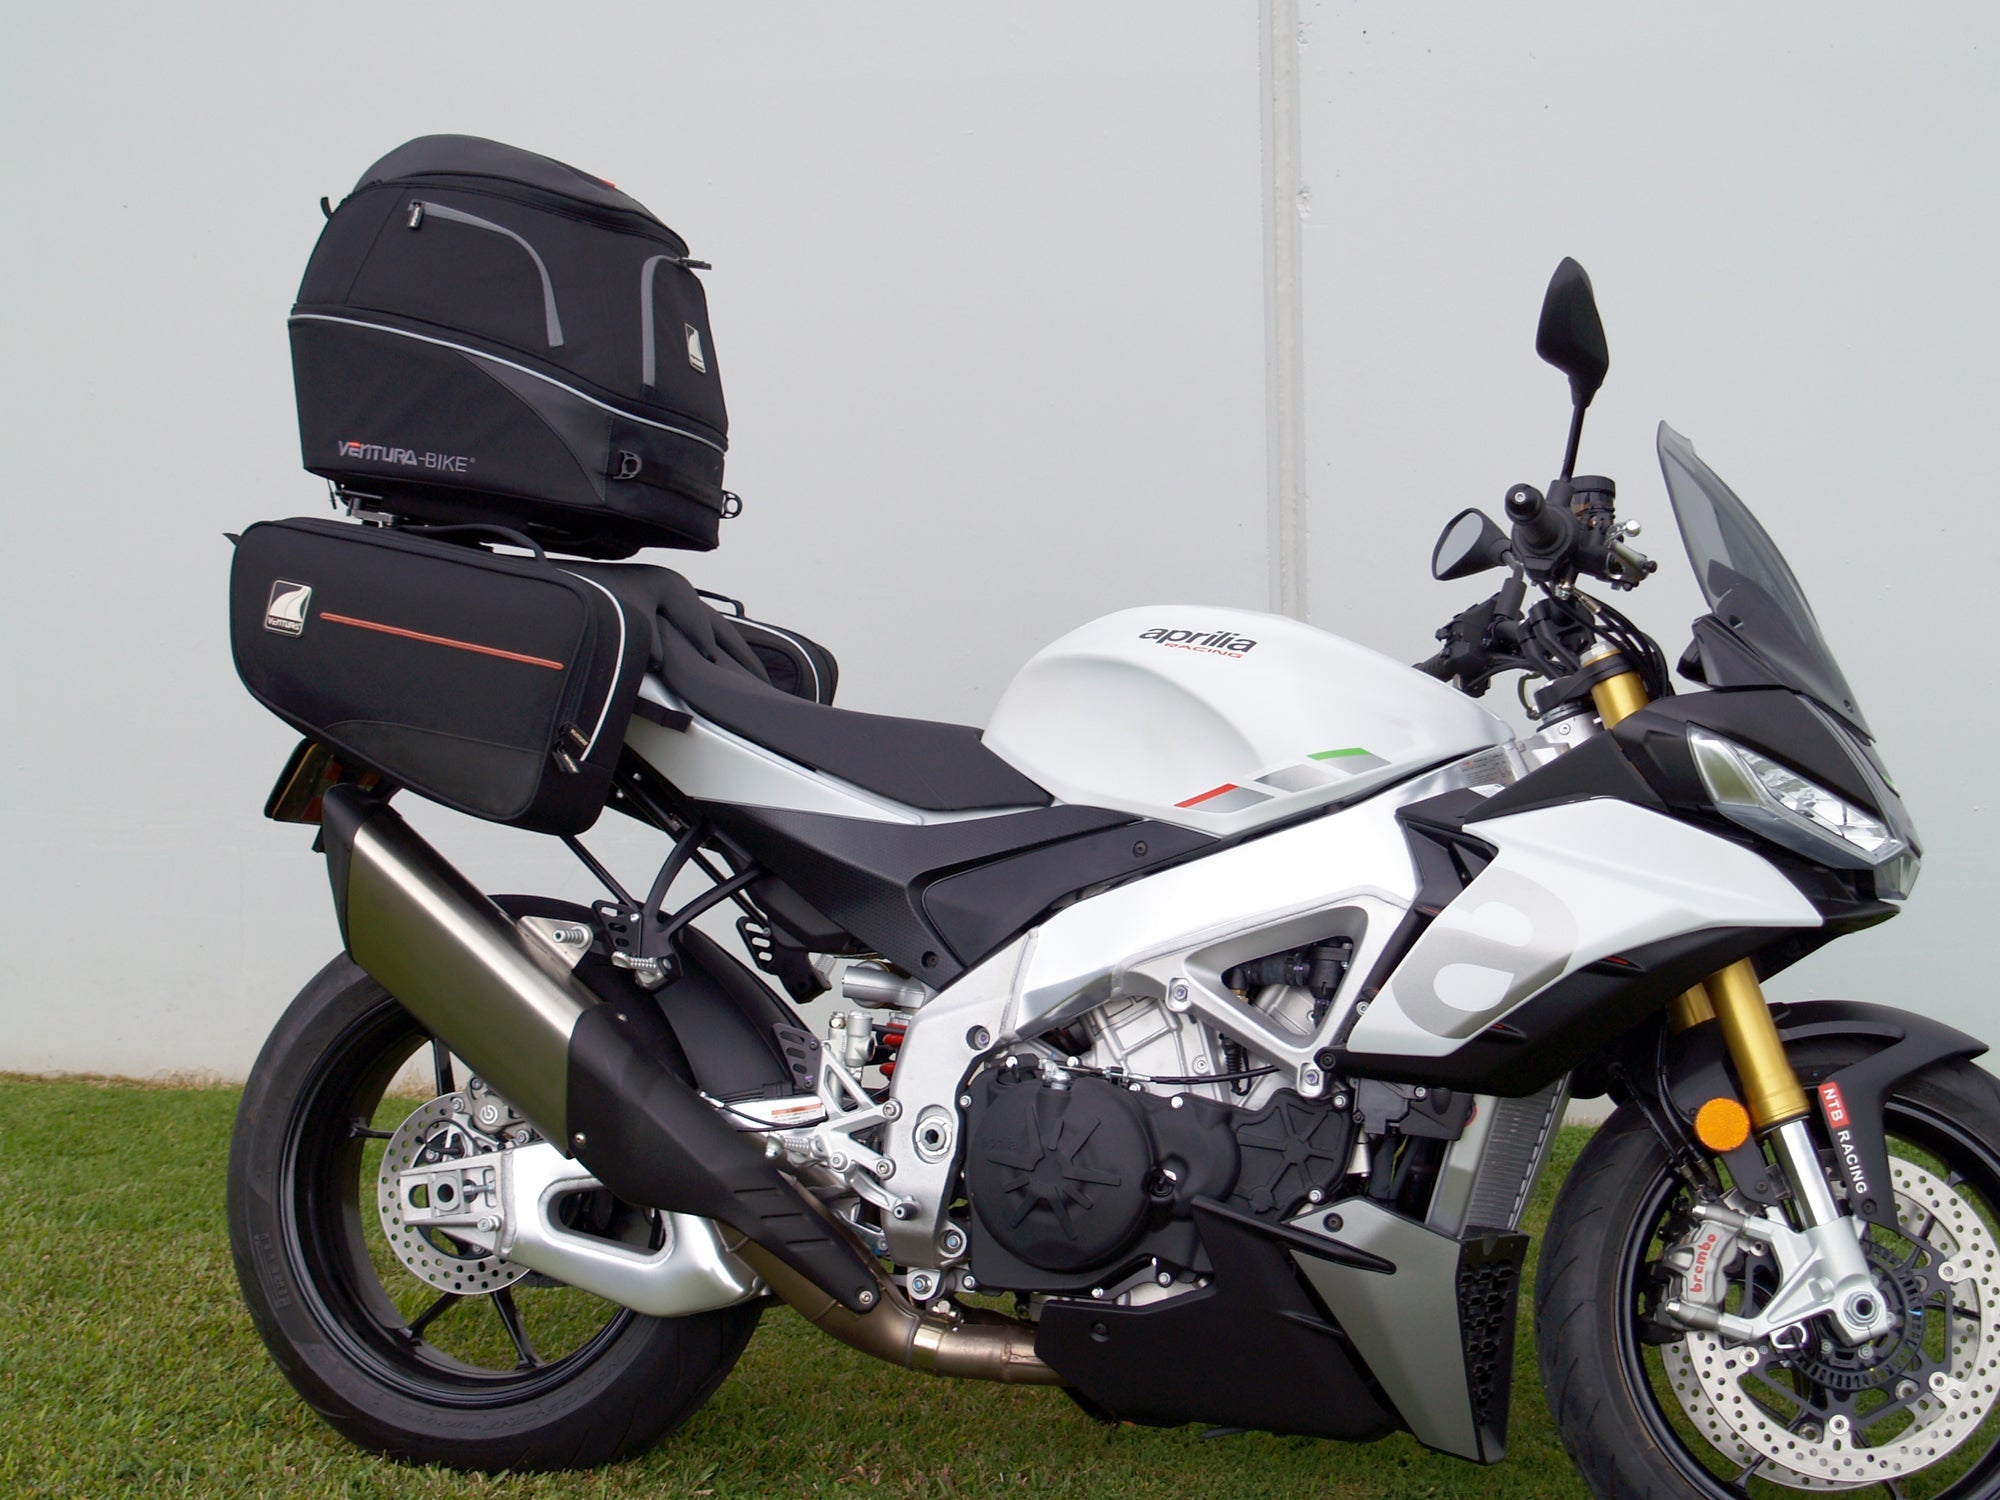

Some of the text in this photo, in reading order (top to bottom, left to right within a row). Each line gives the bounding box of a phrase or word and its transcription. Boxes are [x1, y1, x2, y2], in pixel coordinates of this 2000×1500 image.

[1138, 628, 1257, 652] aprilia
[1164, 642, 1244, 659] RACING
[1823, 1088, 1867, 1194] NTB RACING
[1689, 1233, 1717, 1293] brembo
